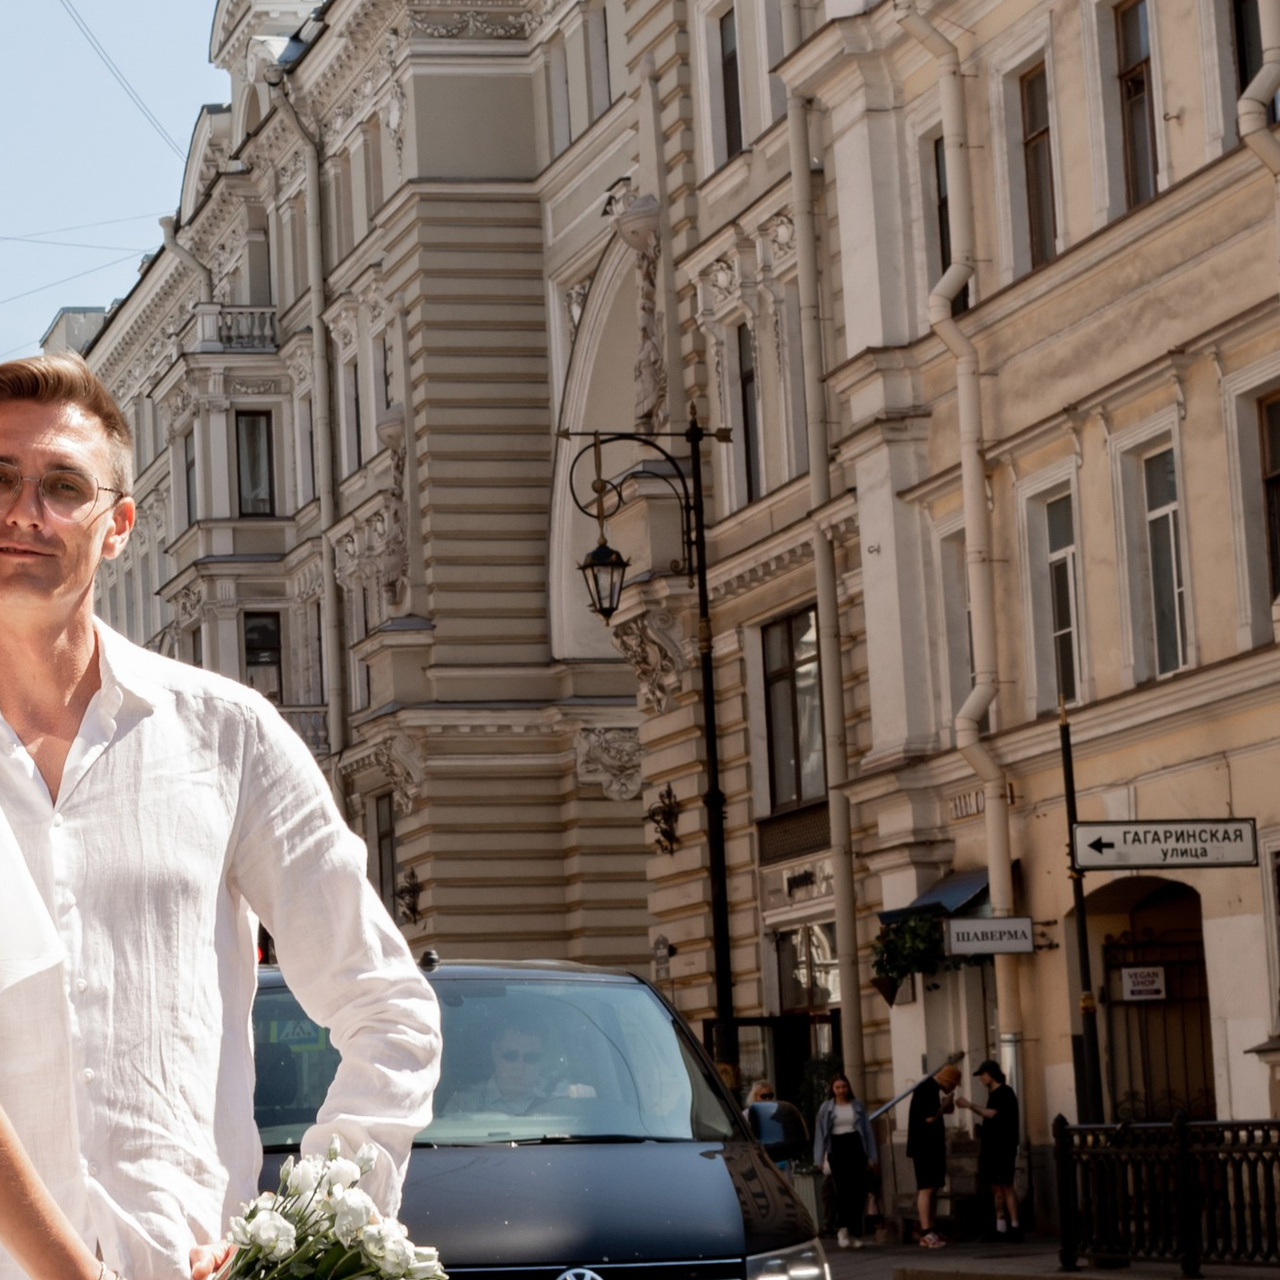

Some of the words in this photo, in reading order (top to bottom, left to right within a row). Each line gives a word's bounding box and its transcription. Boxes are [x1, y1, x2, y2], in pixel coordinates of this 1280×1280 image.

[1123, 829, 1244, 845] ГАГАРИНСКАЯ
[1161, 846, 1208, 862] улица
[956, 929, 1028, 943] ШАВЕРМА
[1128, 971, 1158, 979] VEGAN
[1132, 979, 1156, 987] SHOP
